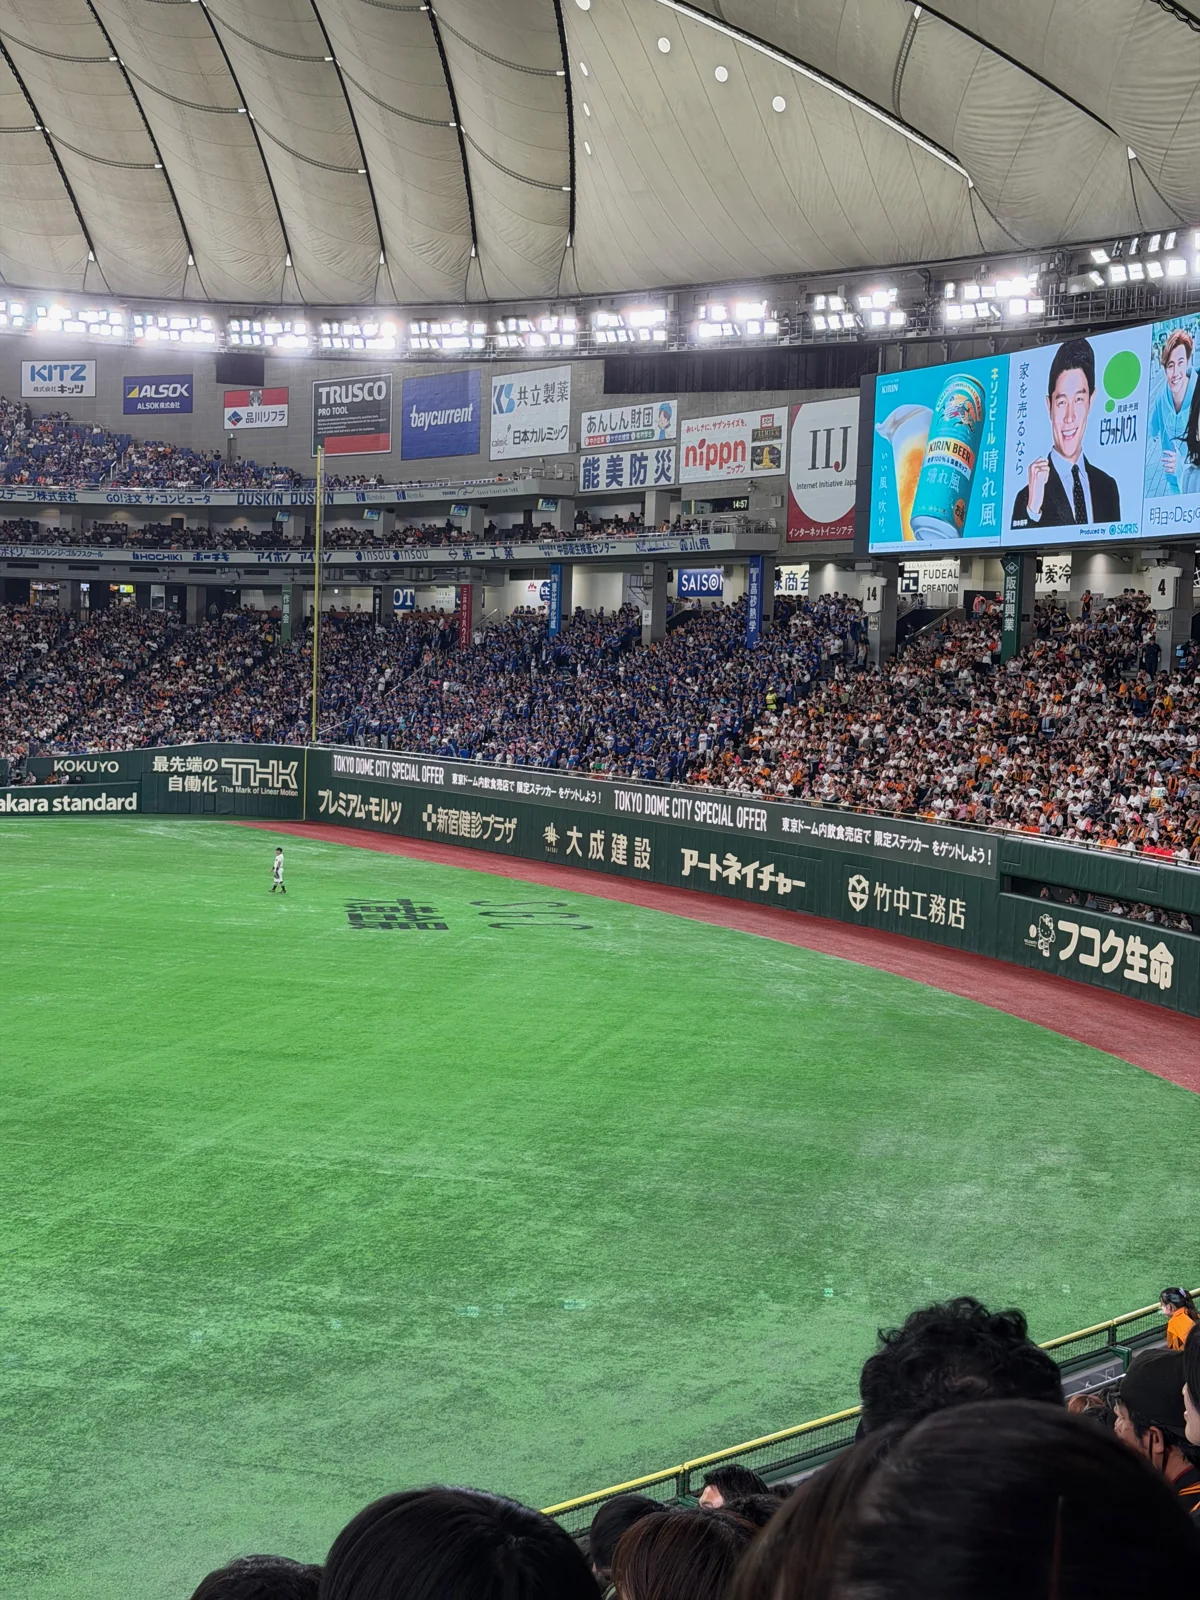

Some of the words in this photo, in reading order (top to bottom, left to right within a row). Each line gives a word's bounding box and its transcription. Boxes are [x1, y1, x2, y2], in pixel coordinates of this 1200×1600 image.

[30, 364, 86, 382] KITZ
[33, 384, 84, 394] 株式会社キッツ
[139, 384, 190, 398] ALSOK
[318, 380, 387, 404] TRUSCO
[516, 380, 570, 408] 共立製薬
[882, 383, 899, 394] KIRIN
[137, 401, 181, 410] ALSOK株式会社
[245, 410, 286, 424] 品川リフラ
[318, 408, 331, 416] PRO
[332, 406, 348, 415] TOOL
[986, 368, 999, 445] キリンビール
[410, 404, 473, 432] baycurrent
[586, 406, 654, 434] あんしん財団
[1014, 361, 1030, 476] 家を売るなら
[1100, 414, 1138, 446] ピタットハウス
[512, 424, 568, 446] 日本カルミック
[685, 438, 746, 471] nippn
[808, 426, 852, 473] IIJ
[928, 440, 952, 453] KIRIN
[952, 444, 971, 464] BEER
[582, 448, 672, 490] 能美防災
[726, 464, 746, 474] ニップン
[796, 481, 818, 490] Internet
[819, 480, 843, 488] Initiative
[878, 452, 888, 534] いい風、吹け。
[979, 448, 1000, 526] 晴れ風
[733, 500, 748, 509] 14:57
[788, 525, 854, 538] インターネットイニシアテ
[1080, 528, 1100, 536] Produced
[140, 553, 183, 561] HOCHIKI
[923, 568, 959, 580] FUDEAL
[1036, 564, 1072, 584] 菱冷
[866, 586, 877, 601] 14
[922, 584, 959, 593] CREATION
[1158, 578, 1166, 596] 4
[749, 583, 758, 632] 高砂熱学
[1004, 576, 1016, 631] 阪和興業
[54, 760, 119, 773] KOKUYO
[152, 756, 218, 772] 最先端の
[221, 758, 299, 789] THK
[334, 755, 354, 774] TOKYO
[355, 758, 374, 776] DOME
[376, 760, 390, 778] CITY
[392, 763, 420, 782] SPECIAL
[422, 766, 444, 785] OFFER
[221, 786, 234, 794] The
[235, 786, 252, 794] Mark
[253, 786, 260, 795] of
[260, 787, 279, 795] Linear
[280, 788, 298, 796] Motion
[452, 773, 515, 793] 東京ドーム内飲食売店で
[516, 781, 557, 796] 限定ステッカー
[52, 792, 137, 812] standard
[318, 789, 402, 825] プレミアム・モルツ
[614, 790, 643, 814] TOKYO
[644, 794, 670, 817] DOME
[672, 798, 693, 820] CITY
[695, 800, 734, 827] SPECIAL
[736, 806, 767, 832] OFFER
[437, 806, 517, 844] 新宿健診プラザ
[566, 826, 651, 870] 大成建設
[781, 817, 871, 843] 東京ドーム内飲食売店で
[874, 830, 928, 852] 限定ステッカー
[932, 841, 992, 865] をゲットしよう!
[680, 848, 806, 895] アートネイチャー
[874, 881, 966, 930] 竹中工務店
[1058, 919, 1174, 990] フコク生命
